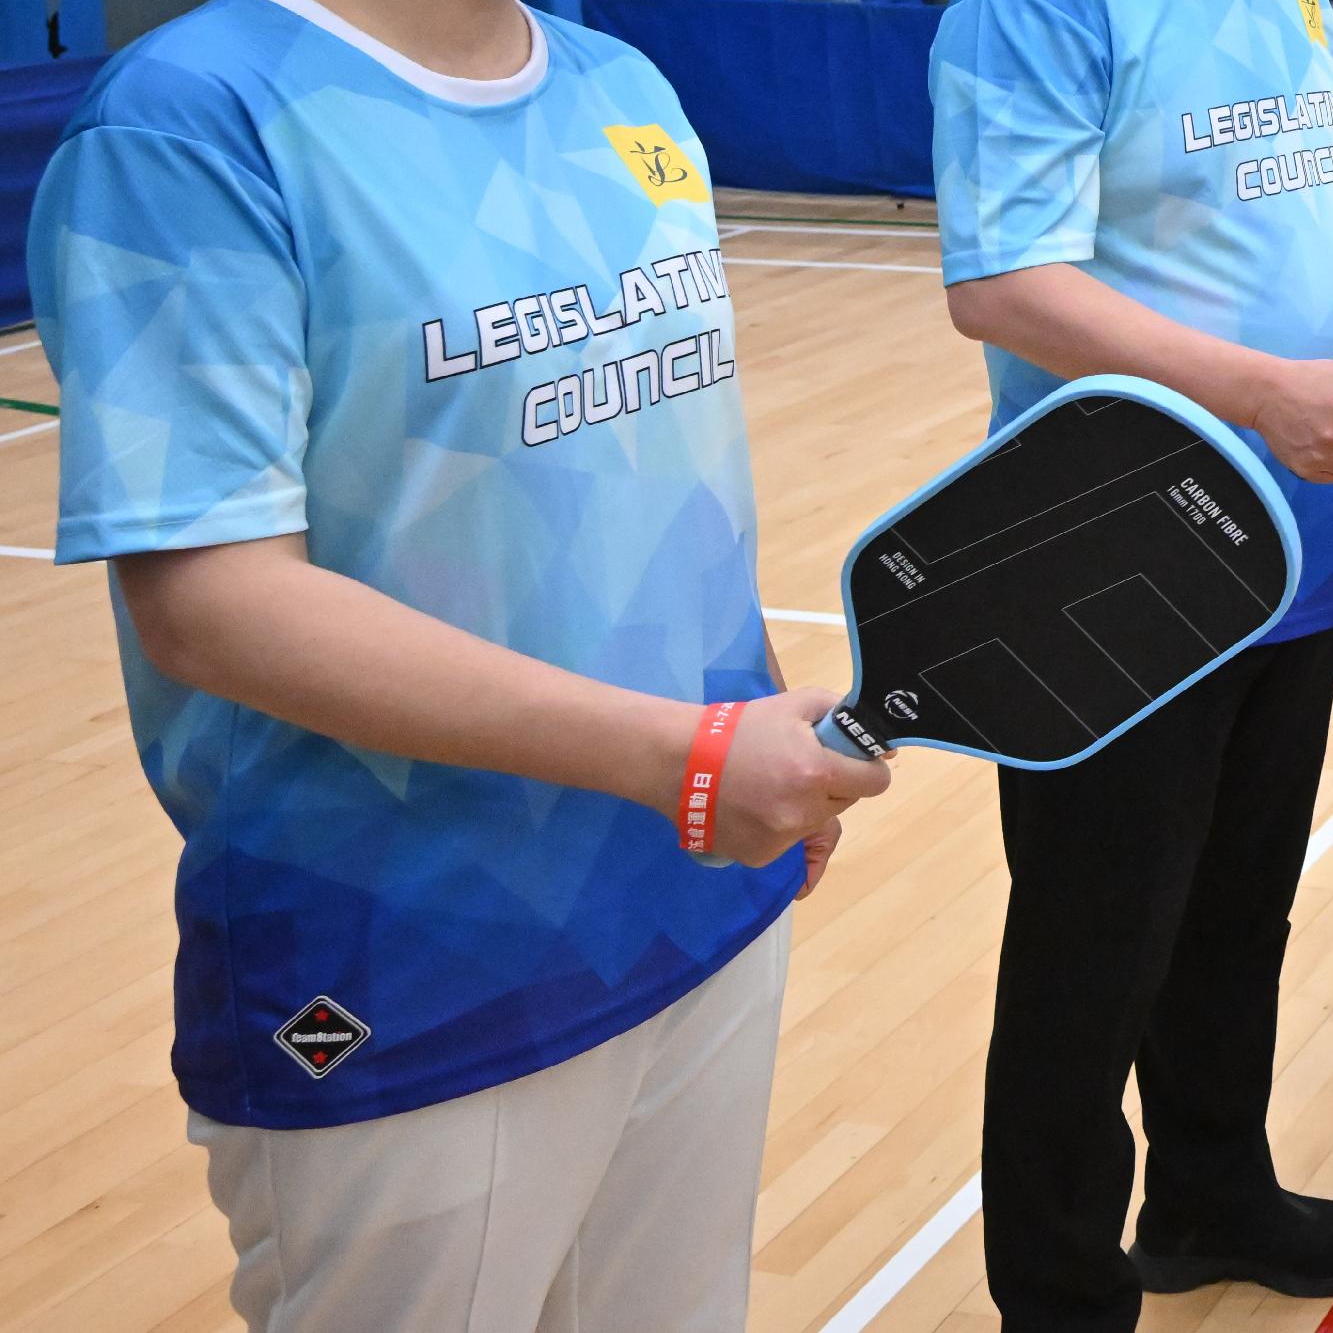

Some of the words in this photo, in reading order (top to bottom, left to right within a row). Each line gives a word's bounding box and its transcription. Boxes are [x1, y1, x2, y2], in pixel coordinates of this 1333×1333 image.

[423, 249, 731, 383] LEGISLATIV
[520, 327, 735, 449] COUNCIL
[1166, 485, 1189, 508] 16mm
[1186, 505, 1207, 525] T700
[1181, 477, 1222, 519] CARBON
[1216, 515, 1249, 546] FIBRE
[878, 553, 900, 573] HONG
[895, 571, 917, 590] KONG
[892, 551, 919, 576] DESIGN
[914, 573, 926, 583] IN
[892, 697, 919, 721] NESA
[835, 711, 887, 758] NESA
